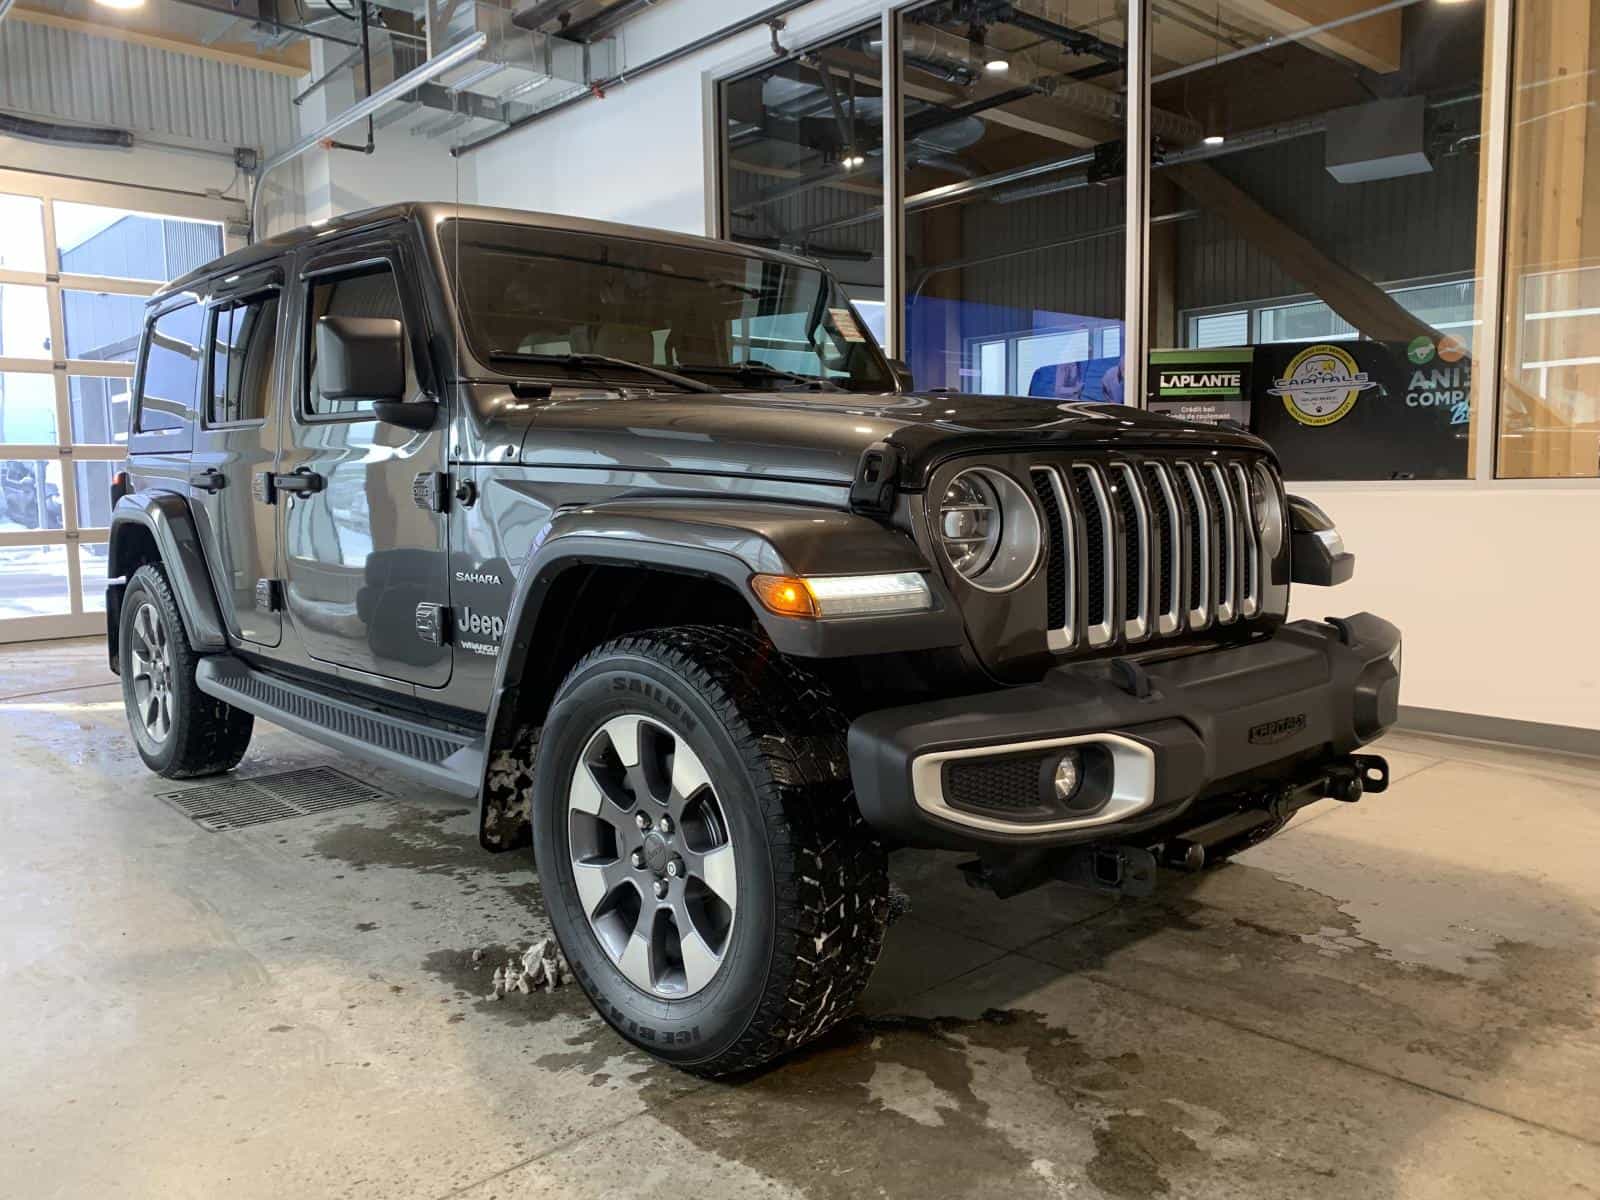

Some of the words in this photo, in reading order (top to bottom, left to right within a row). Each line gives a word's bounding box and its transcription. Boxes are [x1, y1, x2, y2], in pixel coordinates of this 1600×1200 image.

[1160, 374, 1241, 388] LAPLANTE
[455, 571, 502, 585] SAHARA
[458, 606, 504, 641] Jeep
